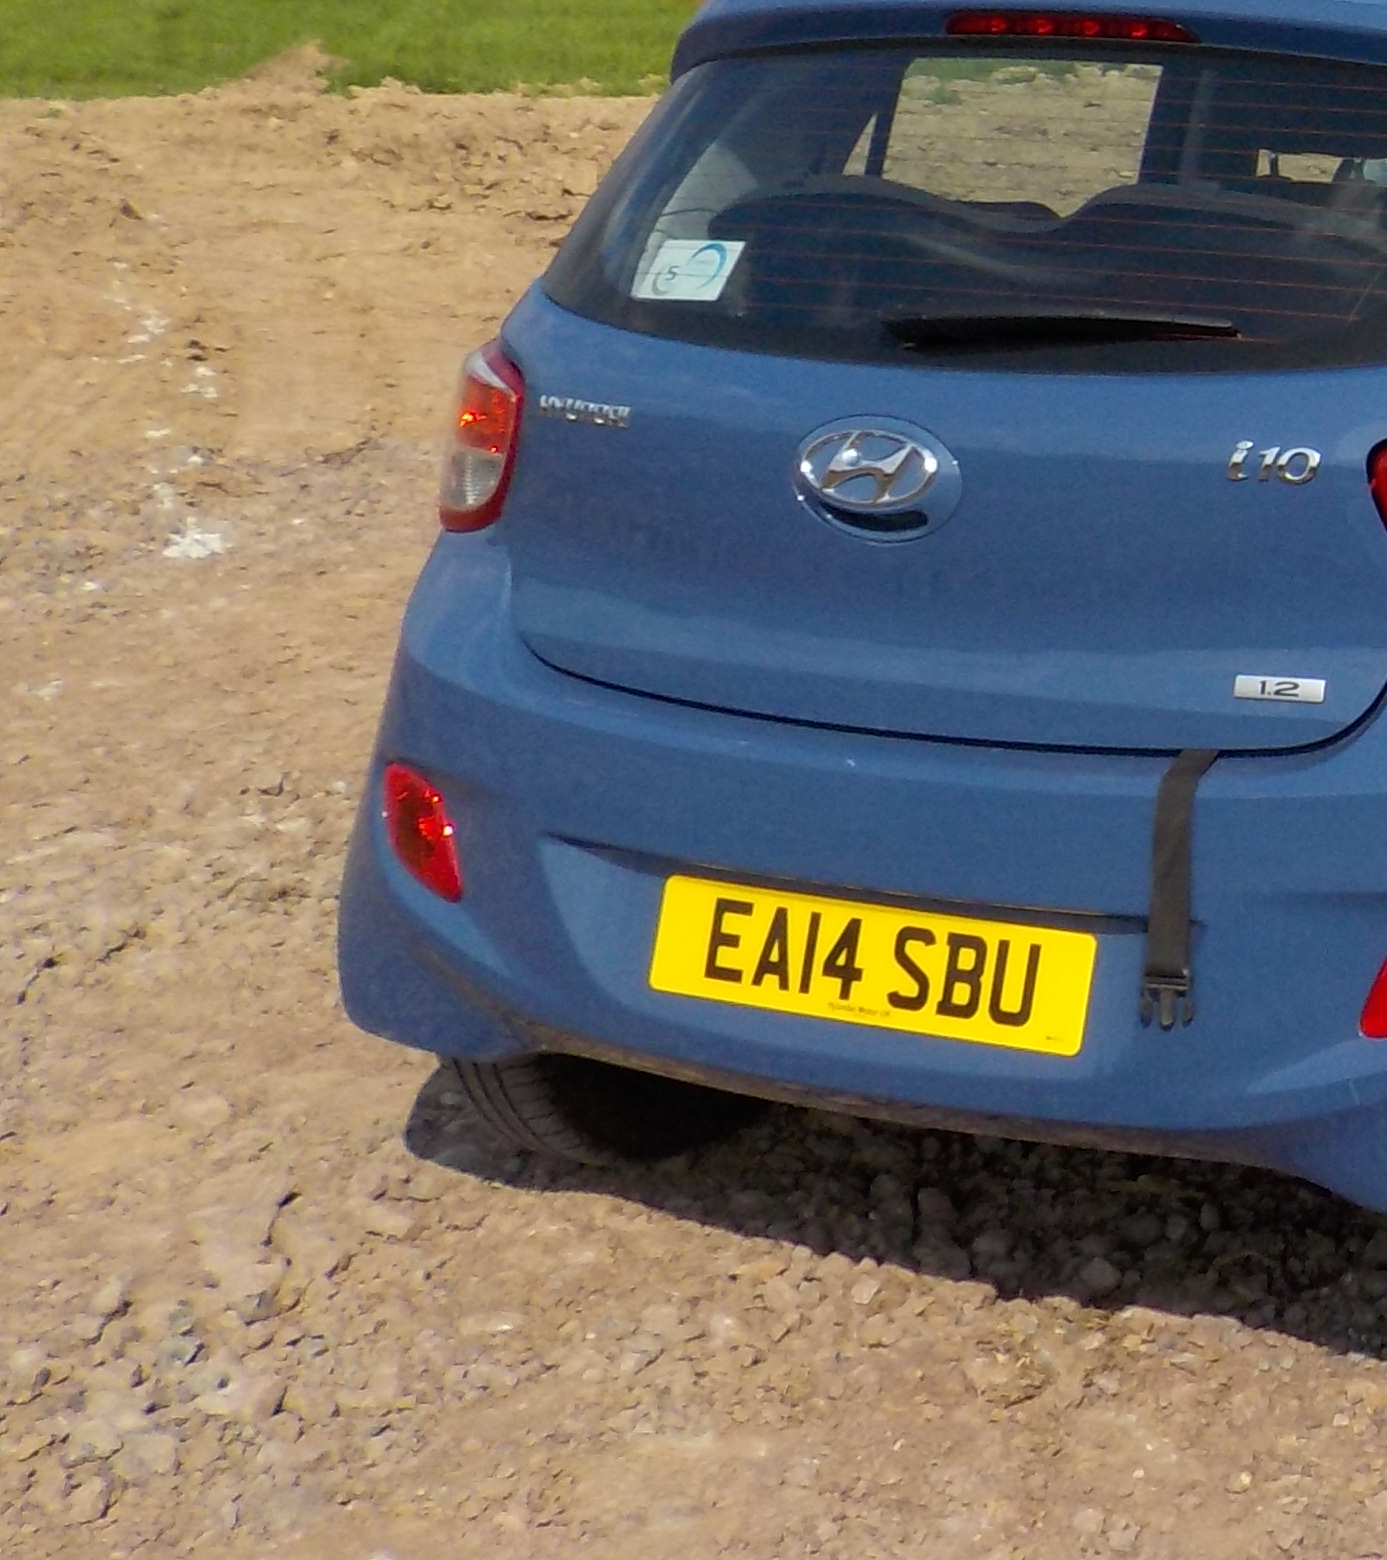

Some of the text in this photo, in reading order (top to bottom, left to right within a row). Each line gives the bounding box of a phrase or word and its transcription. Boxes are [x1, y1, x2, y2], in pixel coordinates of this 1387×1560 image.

[1226, 440, 1322, 485] i10
[1259, 680, 1300, 697] 1.2
[704, 898, 1043, 1028] EA14 SBU
